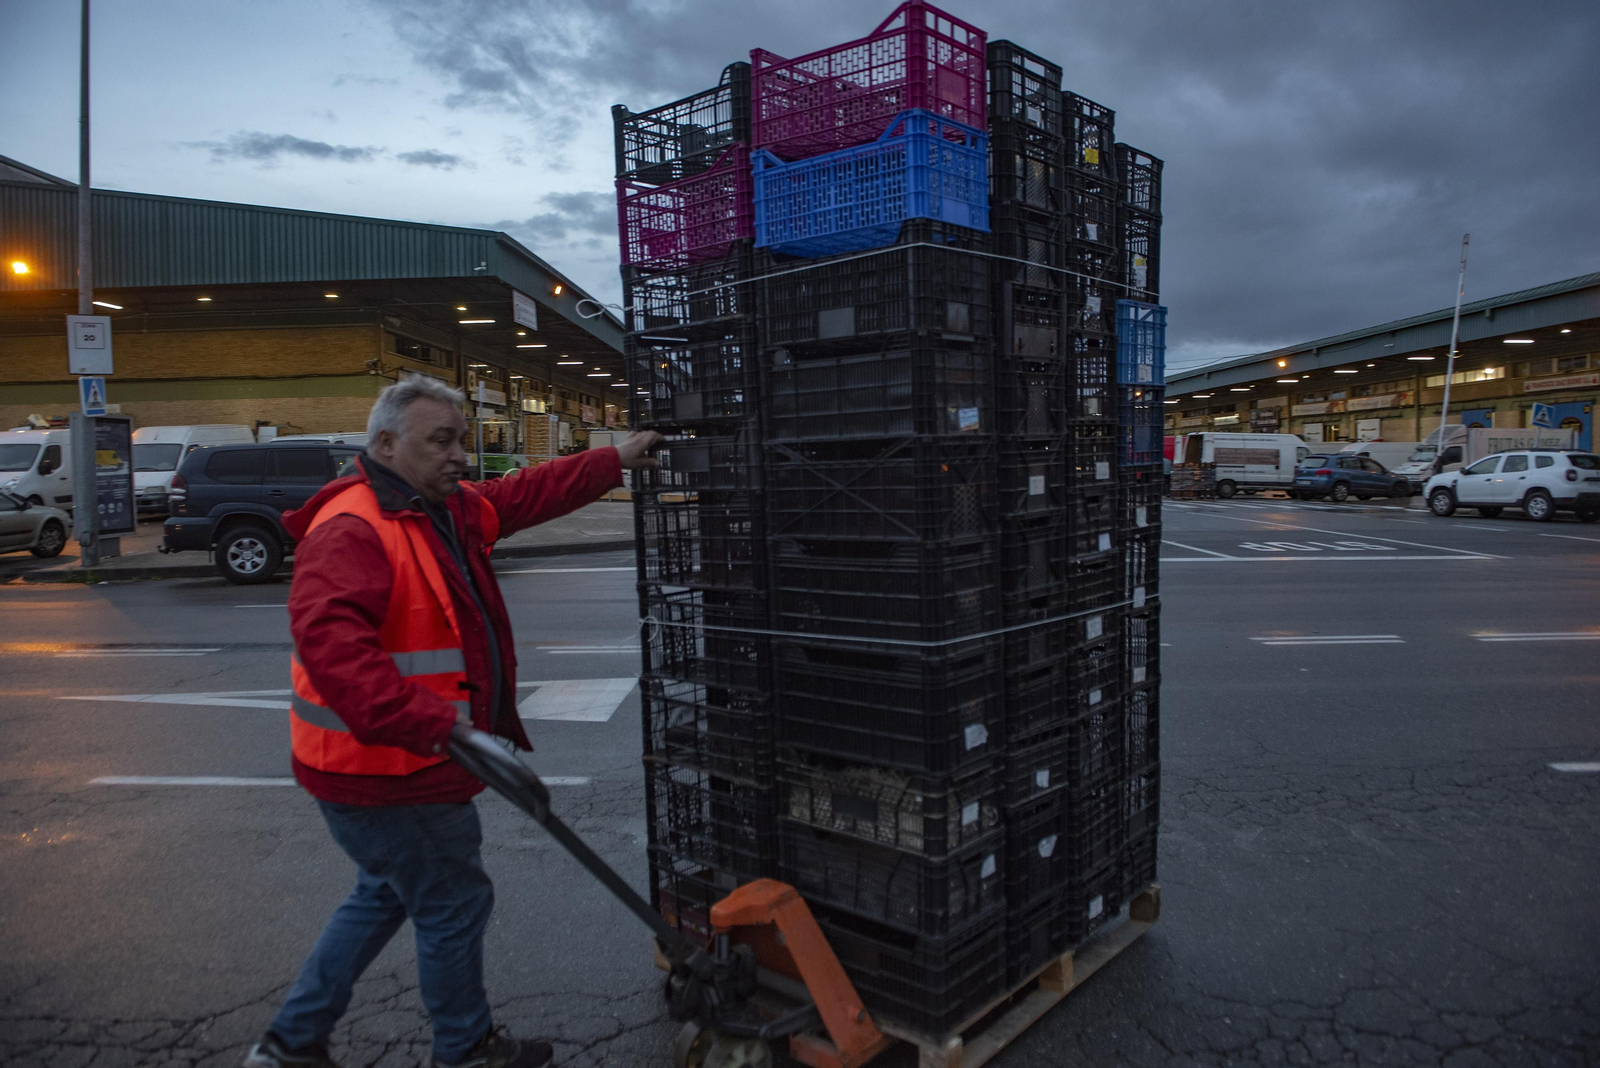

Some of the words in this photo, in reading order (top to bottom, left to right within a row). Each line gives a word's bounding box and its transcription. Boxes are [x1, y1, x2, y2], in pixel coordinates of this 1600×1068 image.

[83, 334, 96, 342] 20
[1488, 437, 1524, 453] FRUTAS
[1527, 437, 1561, 448] GMEZ
